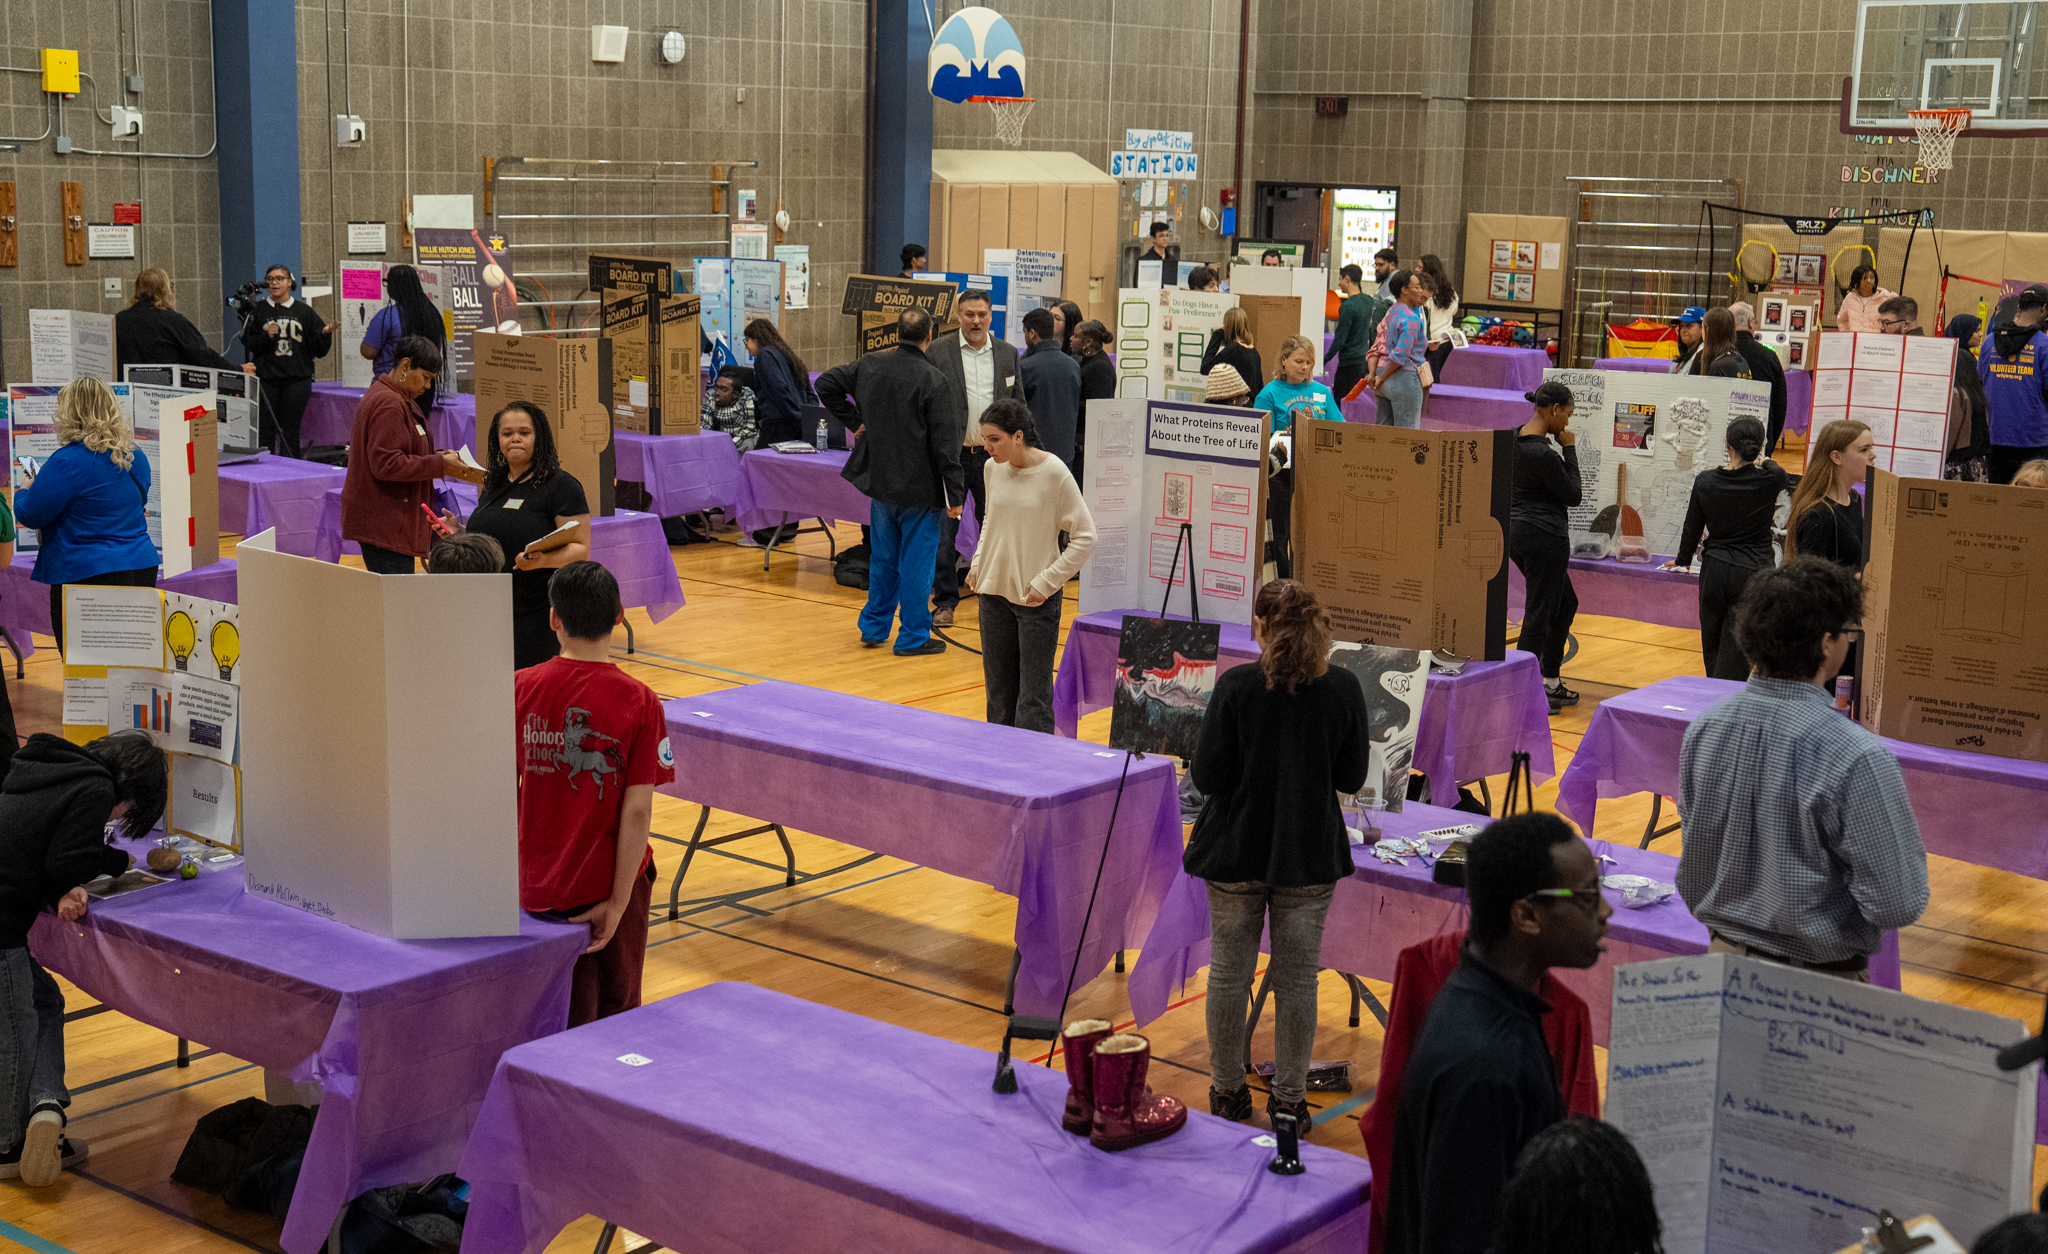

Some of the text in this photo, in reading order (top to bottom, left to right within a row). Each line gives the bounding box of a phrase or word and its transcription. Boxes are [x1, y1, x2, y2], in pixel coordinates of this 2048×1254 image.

[1319, 99, 1338, 112] EXIT
[1112, 154, 1196, 175] STATION
[1840, 166, 1939, 184] DISCHNER
[1356, 217, 1371, 228] PE
[1828, 206, 1936, 228] KILLINGER
[1796, 220, 1820, 229] SKLZ
[1017, 250, 1056, 259] Determining
[1016, 263, 1062, 271] Concentrations
[610, 269, 655, 283] BOARD KIT
[875, 292, 934, 308] BOARD KIT
[1182, 300, 1197, 308] Dogs
[606, 303, 644, 324] BOARD KIT
[662, 304, 700, 320] BOARD KIT
[1184, 308, 1216, 317] Preference
[618, 319, 640, 330] HEADER
[2018, 366, 2033, 375] TEAM
[1629, 405, 1655, 415] PUFF
[1154, 413, 1259, 433] What Proteins Reveal
[1151, 430, 1258, 450] About the Tree of Life
[1468, 440, 1478, 464] Pacon
[1348, 625, 1380, 634] Presentation
[218, 691, 229, 700] voltage
[1940, 699, 1958, 708] trois
[1966, 702, 2005, 716] d'affichage
[220, 708, 232, 717] voltage
[1921, 706, 2025, 728] Triptico para presentaciones
[2007, 710, 2040, 721] Panneau
[527, 713, 549, 731] City
[1922, 716, 2022, 738] Tri-Fold Presentation Board
[524, 724, 564, 745] Honors
[1955, 735, 1985, 747] Pacon
[192, 788, 218, 804] Results
[1726, 967, 1741, 990] A
[1722, 1092, 1735, 1108] A
